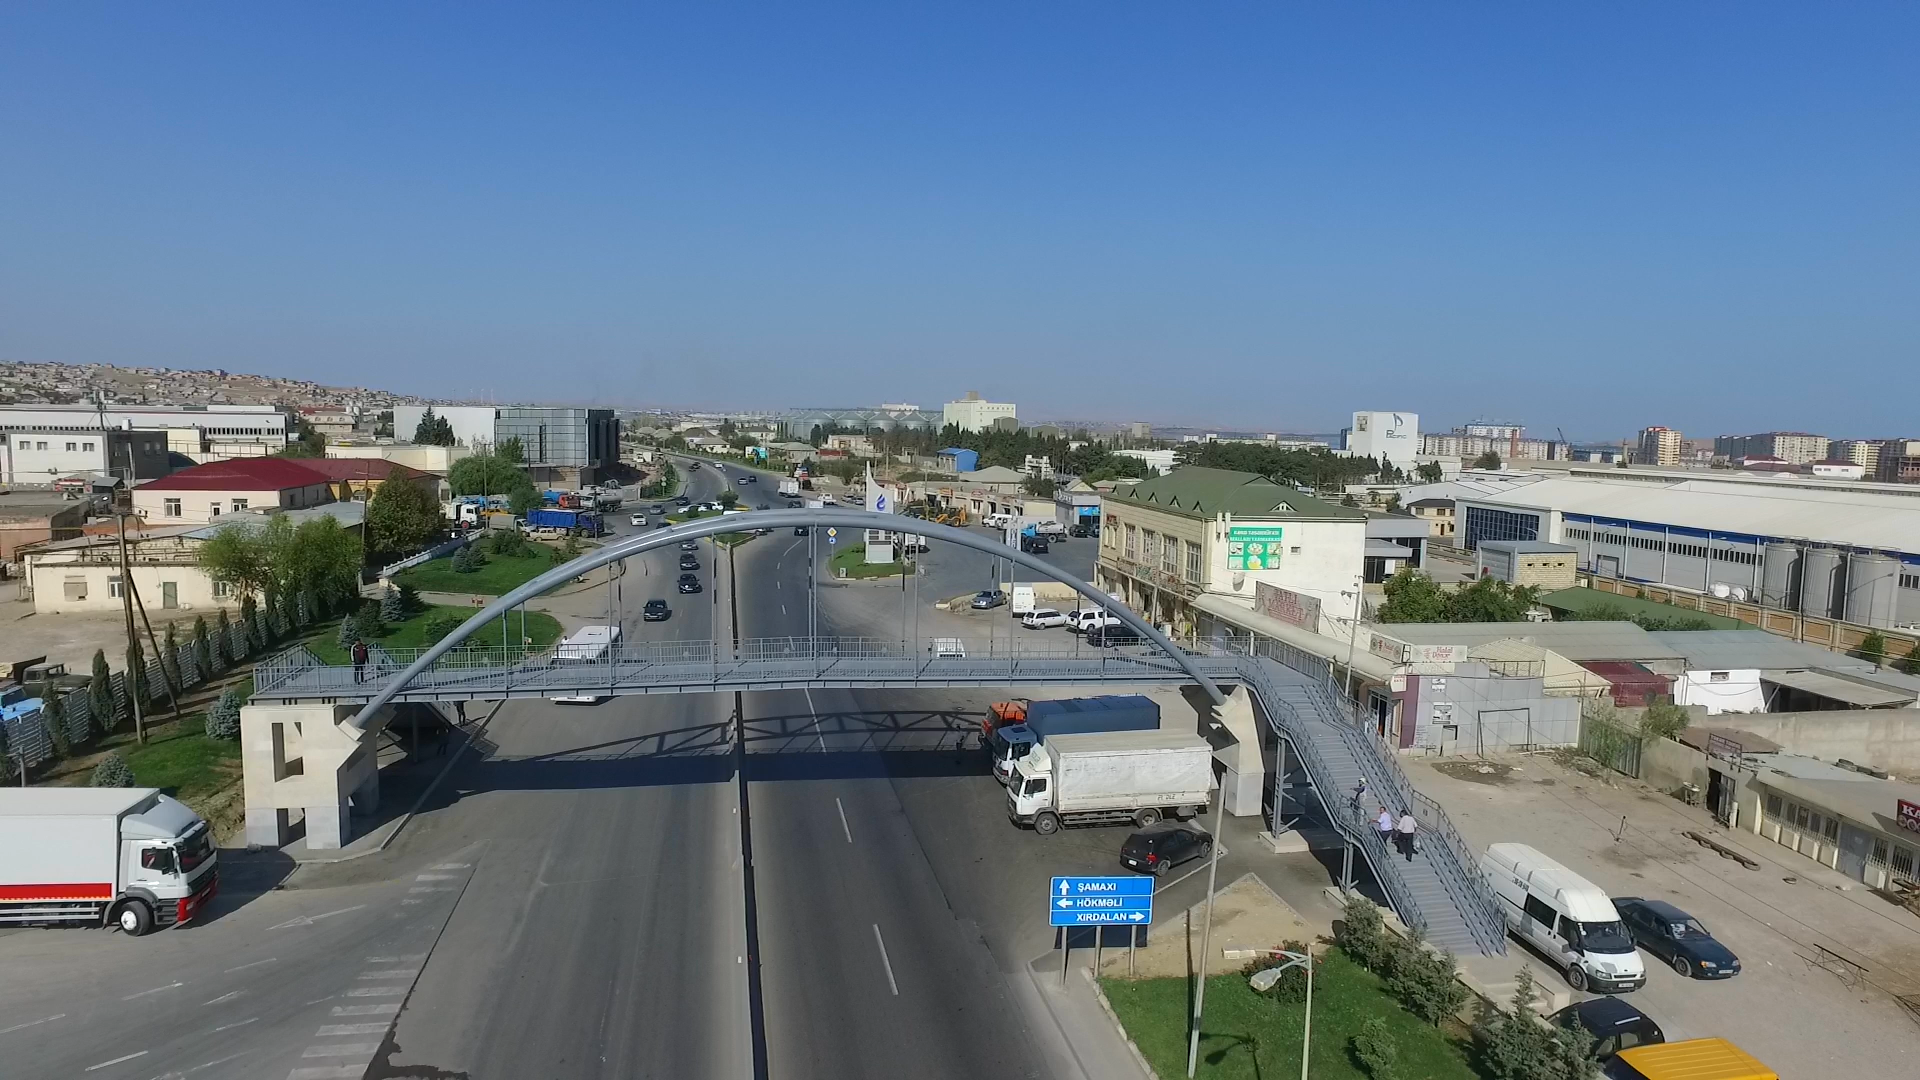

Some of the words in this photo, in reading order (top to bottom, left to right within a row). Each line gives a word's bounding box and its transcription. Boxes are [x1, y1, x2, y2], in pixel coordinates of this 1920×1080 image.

[1077, 882, 1117, 893] ŞAMAXI
[1076, 897, 1123, 907] HÖKMƏLİ
[1076, 913, 1127, 921] XIRDALAN
